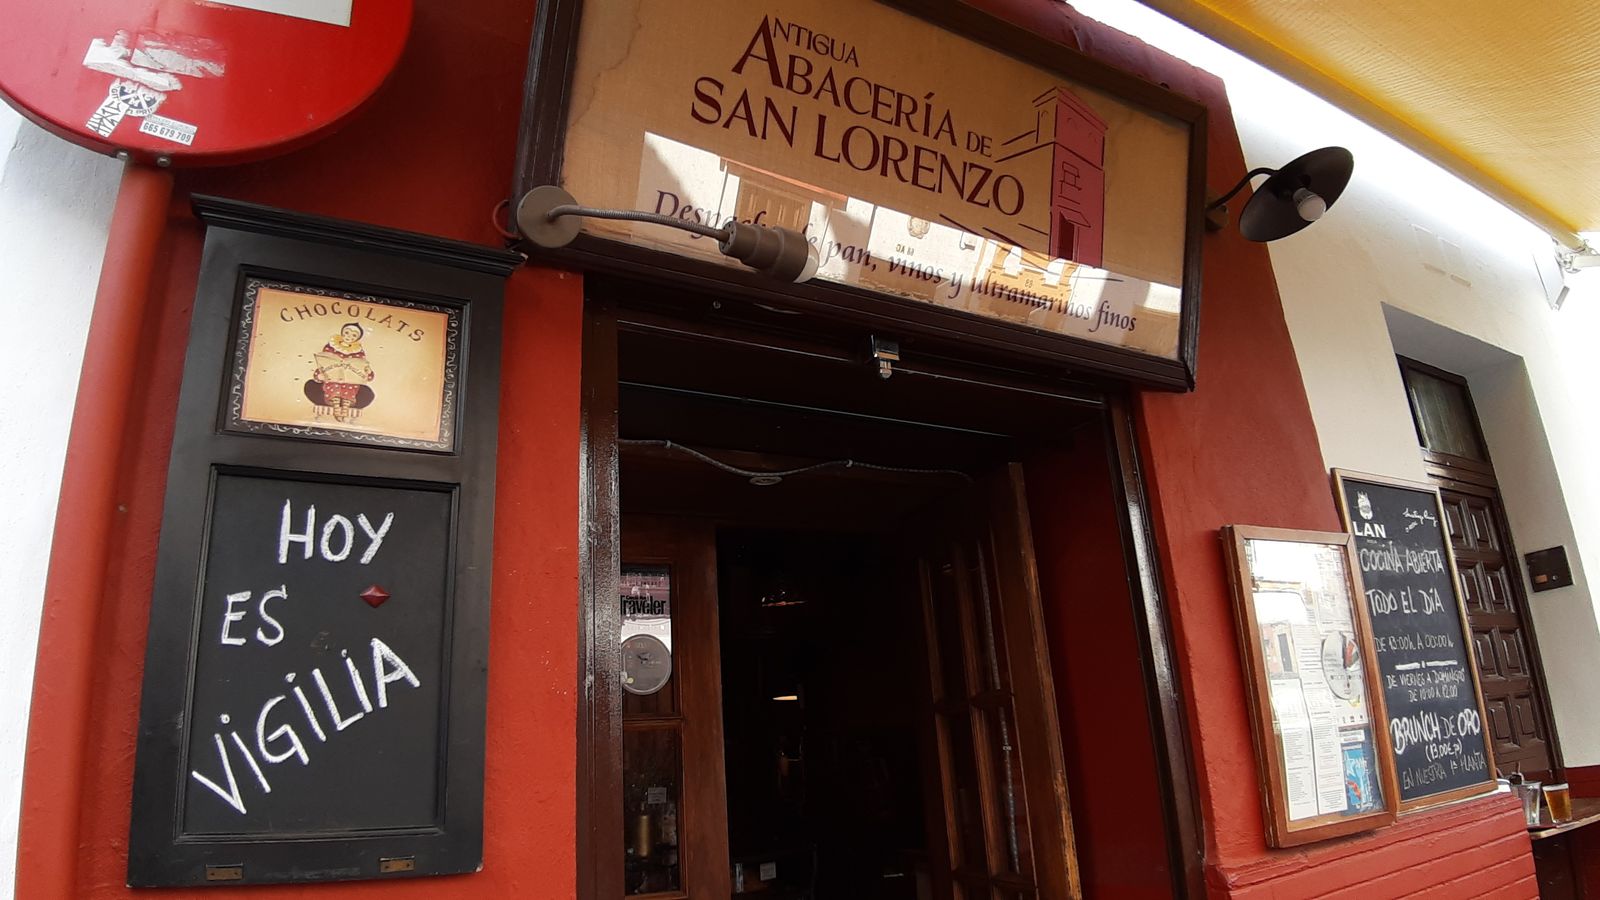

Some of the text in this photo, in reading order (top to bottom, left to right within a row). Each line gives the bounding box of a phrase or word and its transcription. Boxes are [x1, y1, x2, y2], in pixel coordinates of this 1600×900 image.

[731, 14, 993, 158] ABACERÍA DE
[159, 127, 175, 138] 679
[176, 132, 192, 143] 709
[690, 76, 1025, 216] SAN LORENZO
[819, 240, 877, 272] pan,
[888, 255, 944, 284] vinos
[947, 271, 964, 299] y
[970, 270, 1093, 321] ultramarinos
[1088, 300, 1137, 333] finos
[280, 301, 425, 343] CHOCOLATS
[278, 499, 394, 565] HOY
[1352, 521, 1387, 539] LAN
[1406, 547, 1446, 575] ABIERTA
[221, 584, 289, 647] ES
[1365, 589, 1398, 616] TODO
[1401, 585, 1418, 614] EL
[1373, 636, 1387, 652] DE
[1416, 632, 1425, 650] A
[1386, 667, 1466, 689] DE VIERNES A DOMINGOS
[1408, 688, 1418, 702] DE
[1390, 710, 1441, 755] BRUNCH
[1440, 715, 1457, 739] DE
[1457, 708, 1480, 737] ORO
[1402, 767, 1415, 790] EN
